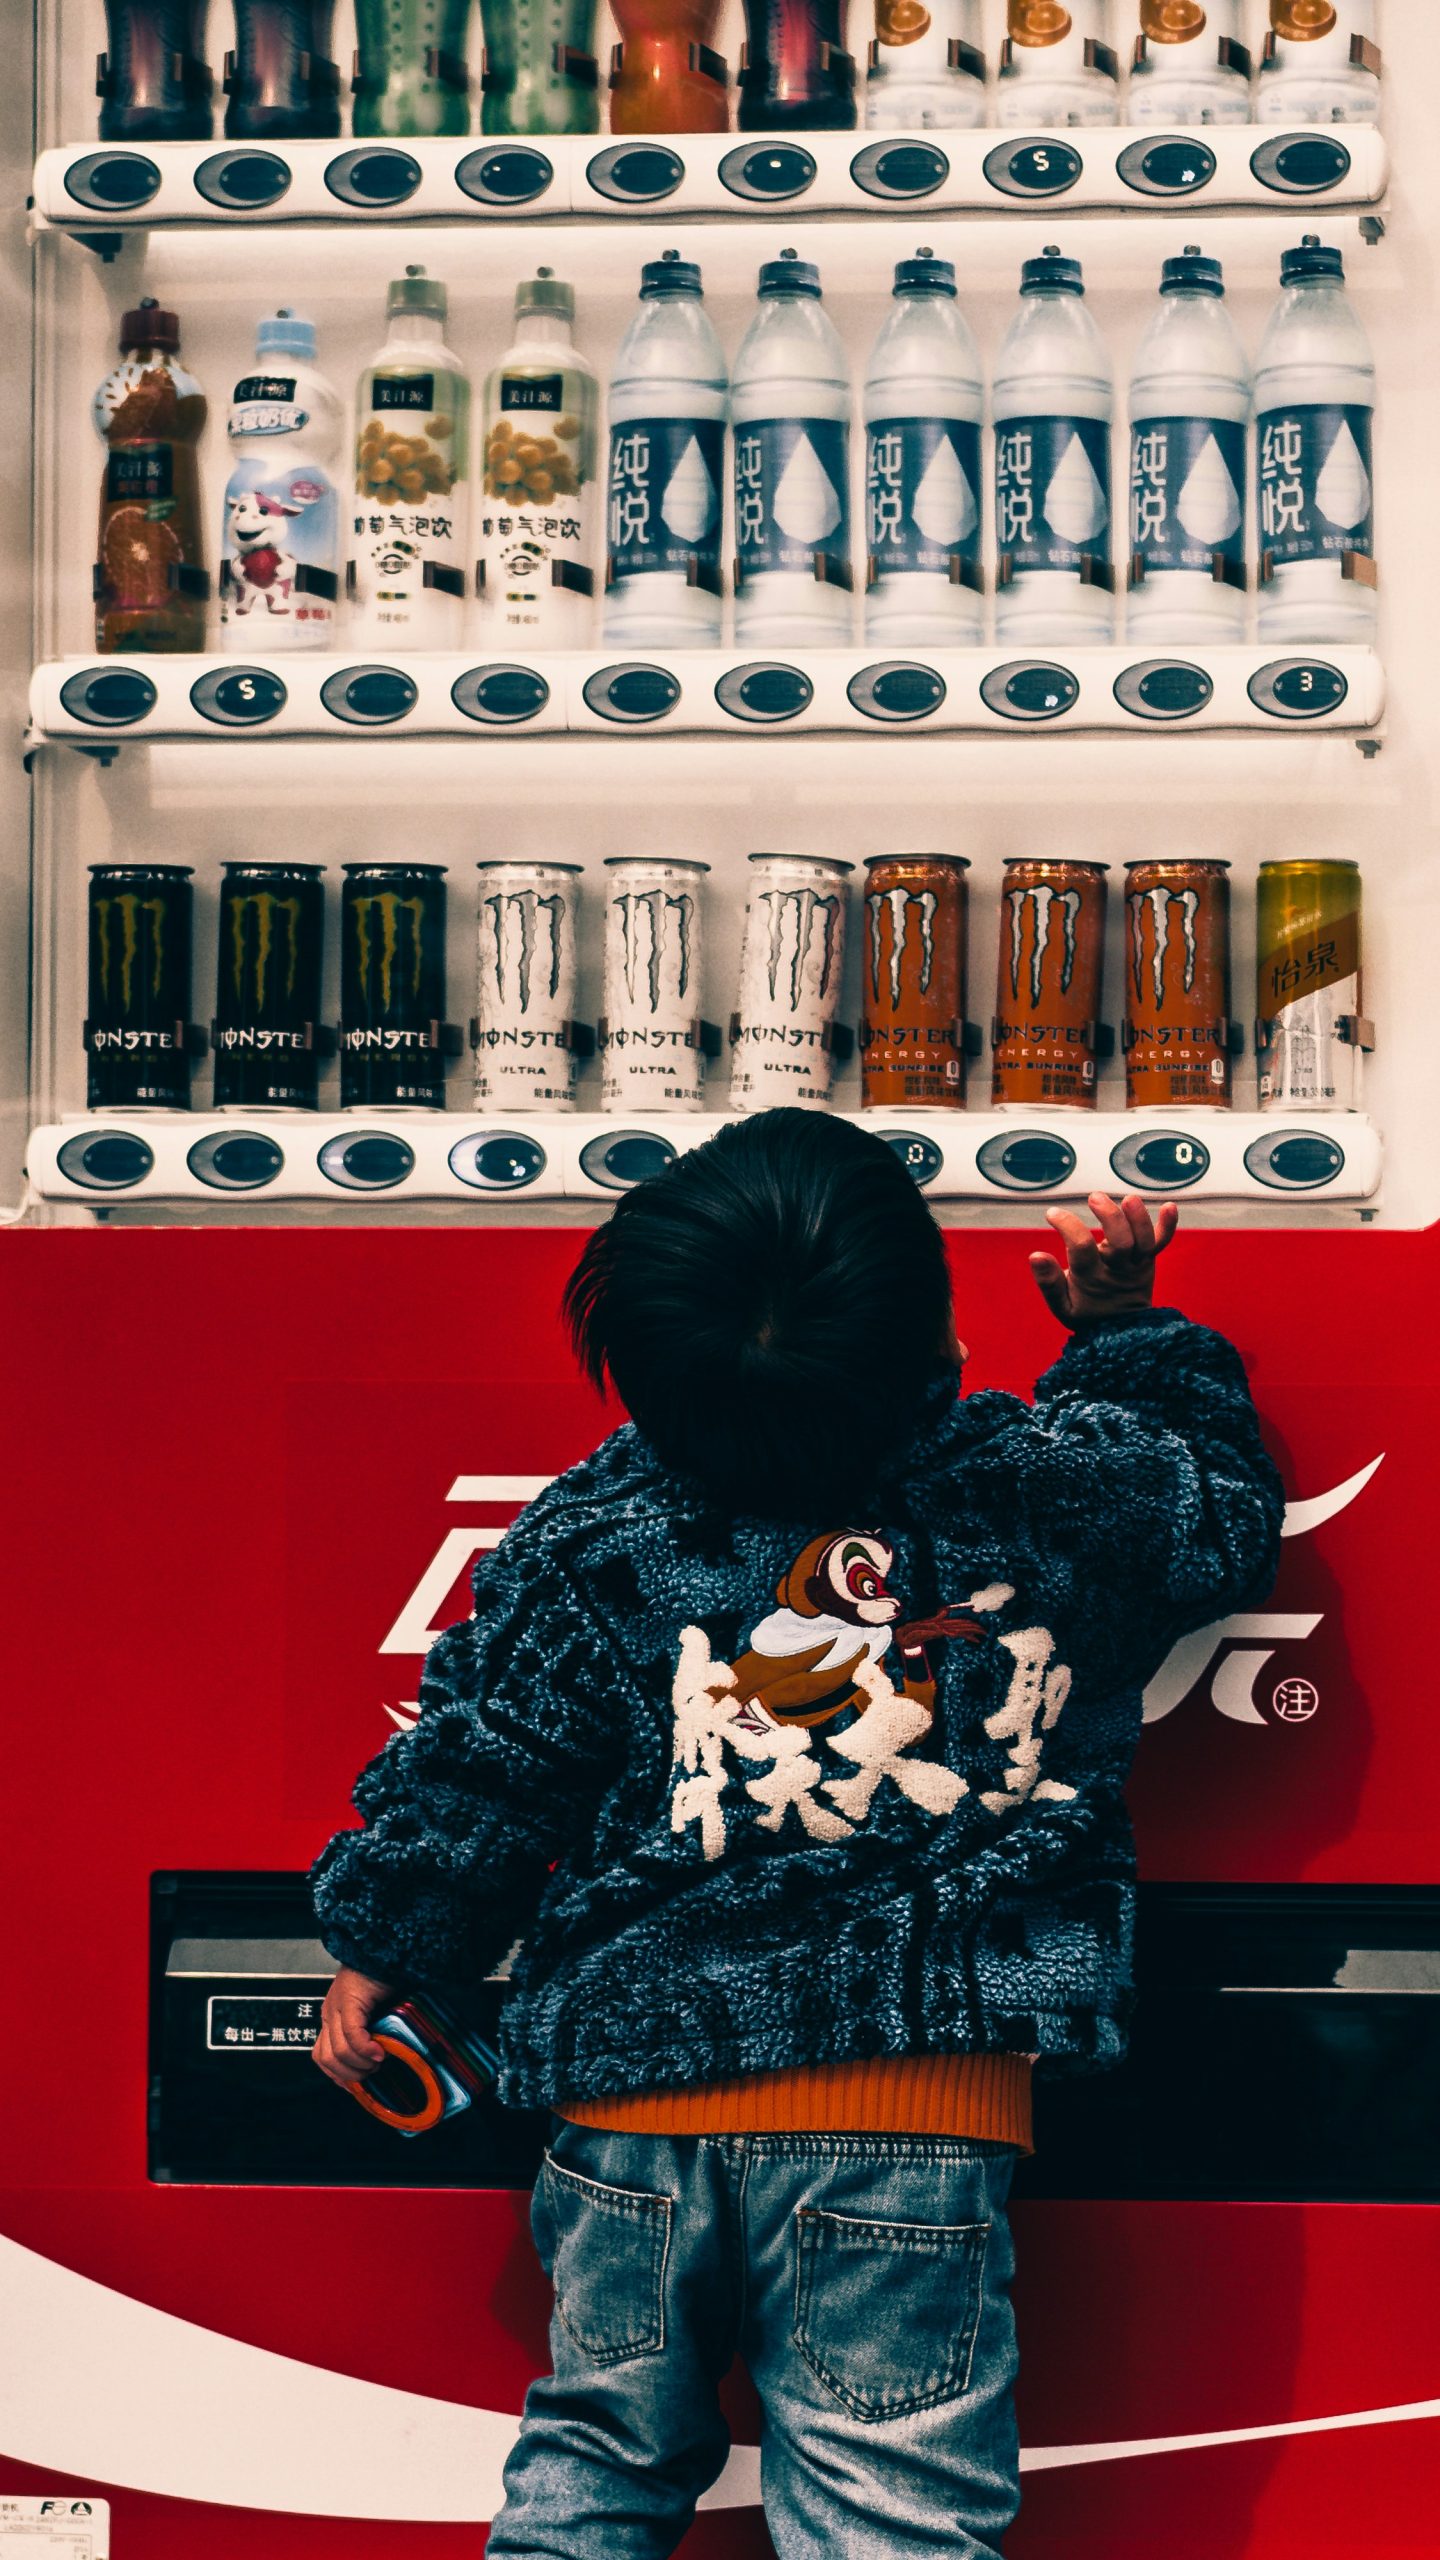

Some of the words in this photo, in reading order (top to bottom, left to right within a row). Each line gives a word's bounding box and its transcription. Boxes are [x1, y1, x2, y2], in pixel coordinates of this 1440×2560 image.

[612, 433, 650, 546] 纯悦
[868, 432, 902, 544] 纯悦
[998, 431, 1033, 543] 纯悦
[1131, 431, 1168, 543] 纯悦
[1262, 420, 1304, 536] 纯悦
[736, 435, 766, 545] 纯悦
[1300, 672, 1313, 692] 3
[1272, 940, 1338, 998] 怡泉
[94, 1028, 172, 1051] ONSTE
[221, 1027, 304, 1050] ONSTE
[345, 1027, 429, 1051] ONSTE
[480, 1027, 566, 1049] ONSTE
[608, 1027, 693, 1049] ONSTE
[500, 1066, 546, 1075] ULTRA
[629, 1066, 676, 1075] ULTRA
[764, 1063, 811, 1075] ULTRA
[1175, 1142, 1192, 1164] 0
[298, 2003, 313, 2018] 注
[225, 2027, 317, 2042] 每出一瓶饮料
